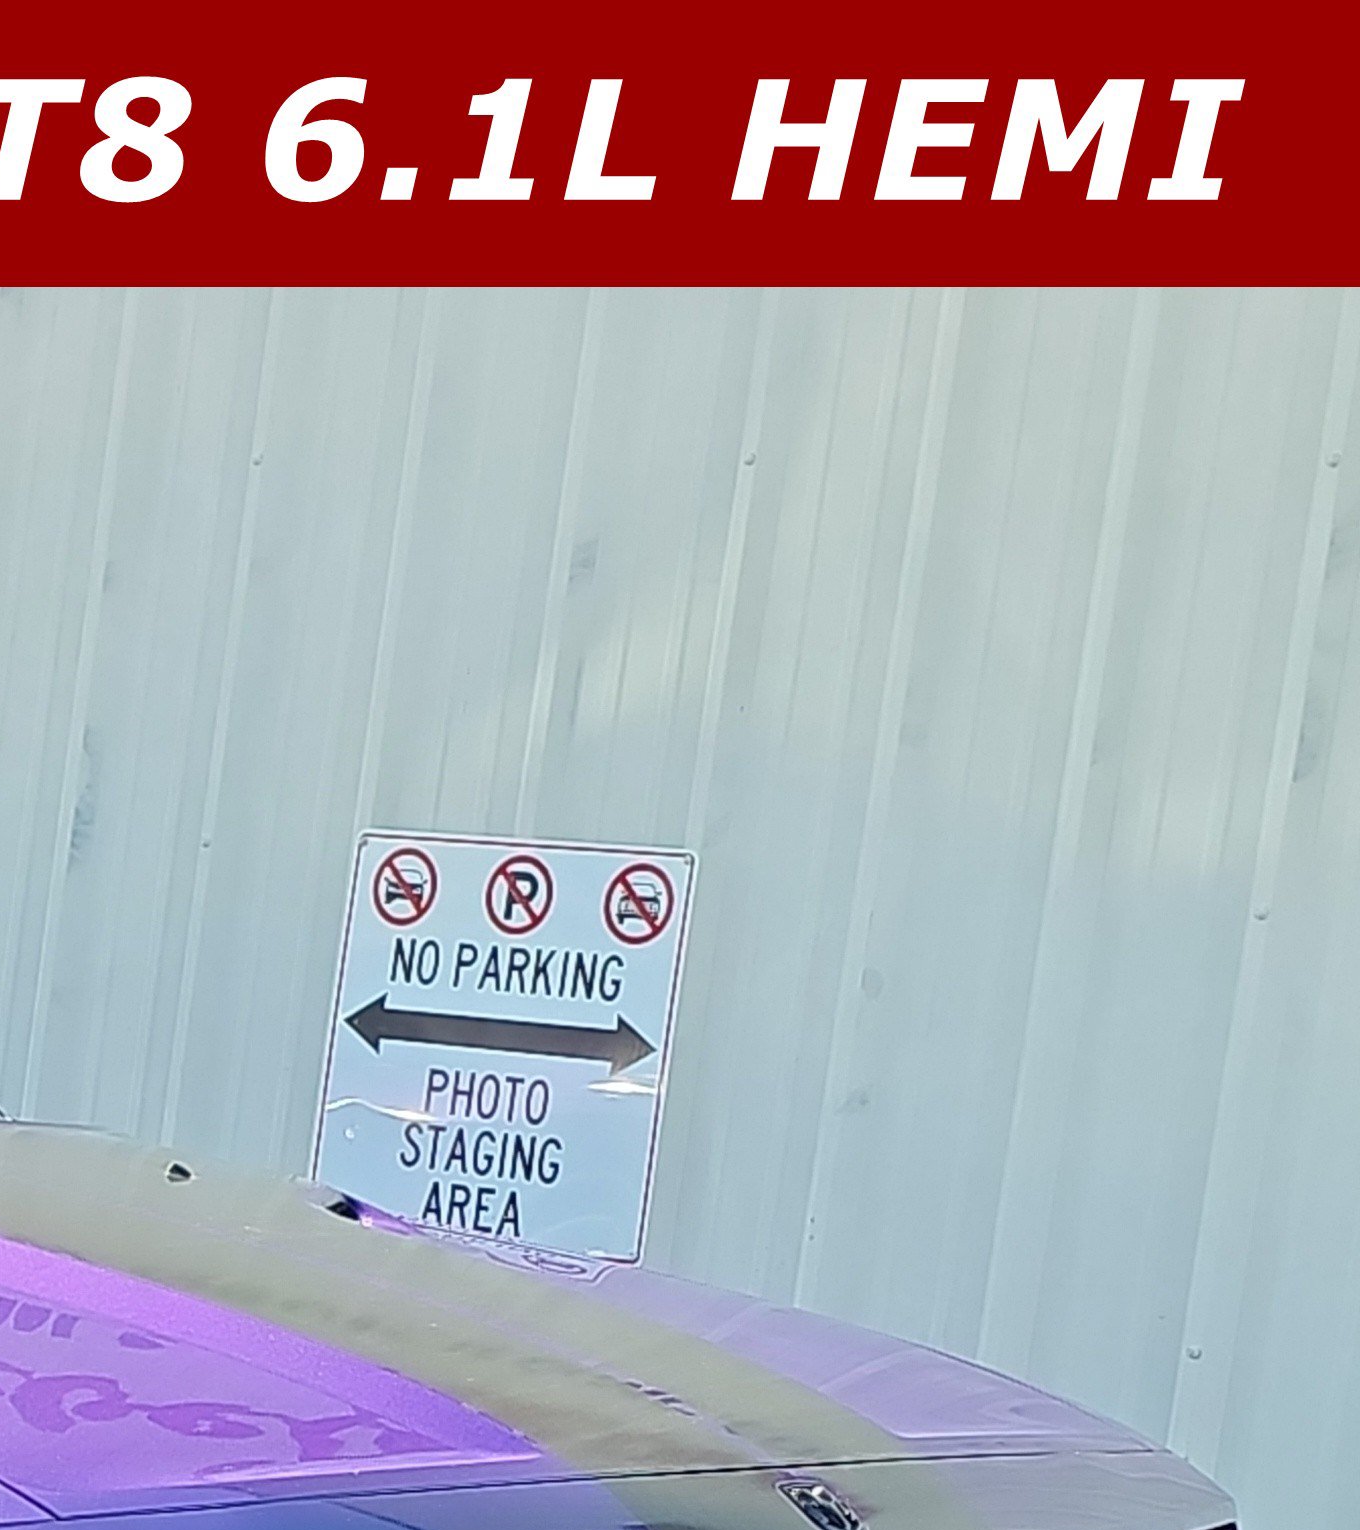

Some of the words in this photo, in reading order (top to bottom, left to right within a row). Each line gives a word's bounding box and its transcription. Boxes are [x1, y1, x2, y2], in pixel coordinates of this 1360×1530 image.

[389, 937, 441, 986] NO
[453, 942, 625, 1002] PARKING
[424, 1068, 550, 1125] PHOTO
[399, 1122, 563, 1184] STAGING
[421, 1181, 521, 1238] AREA
